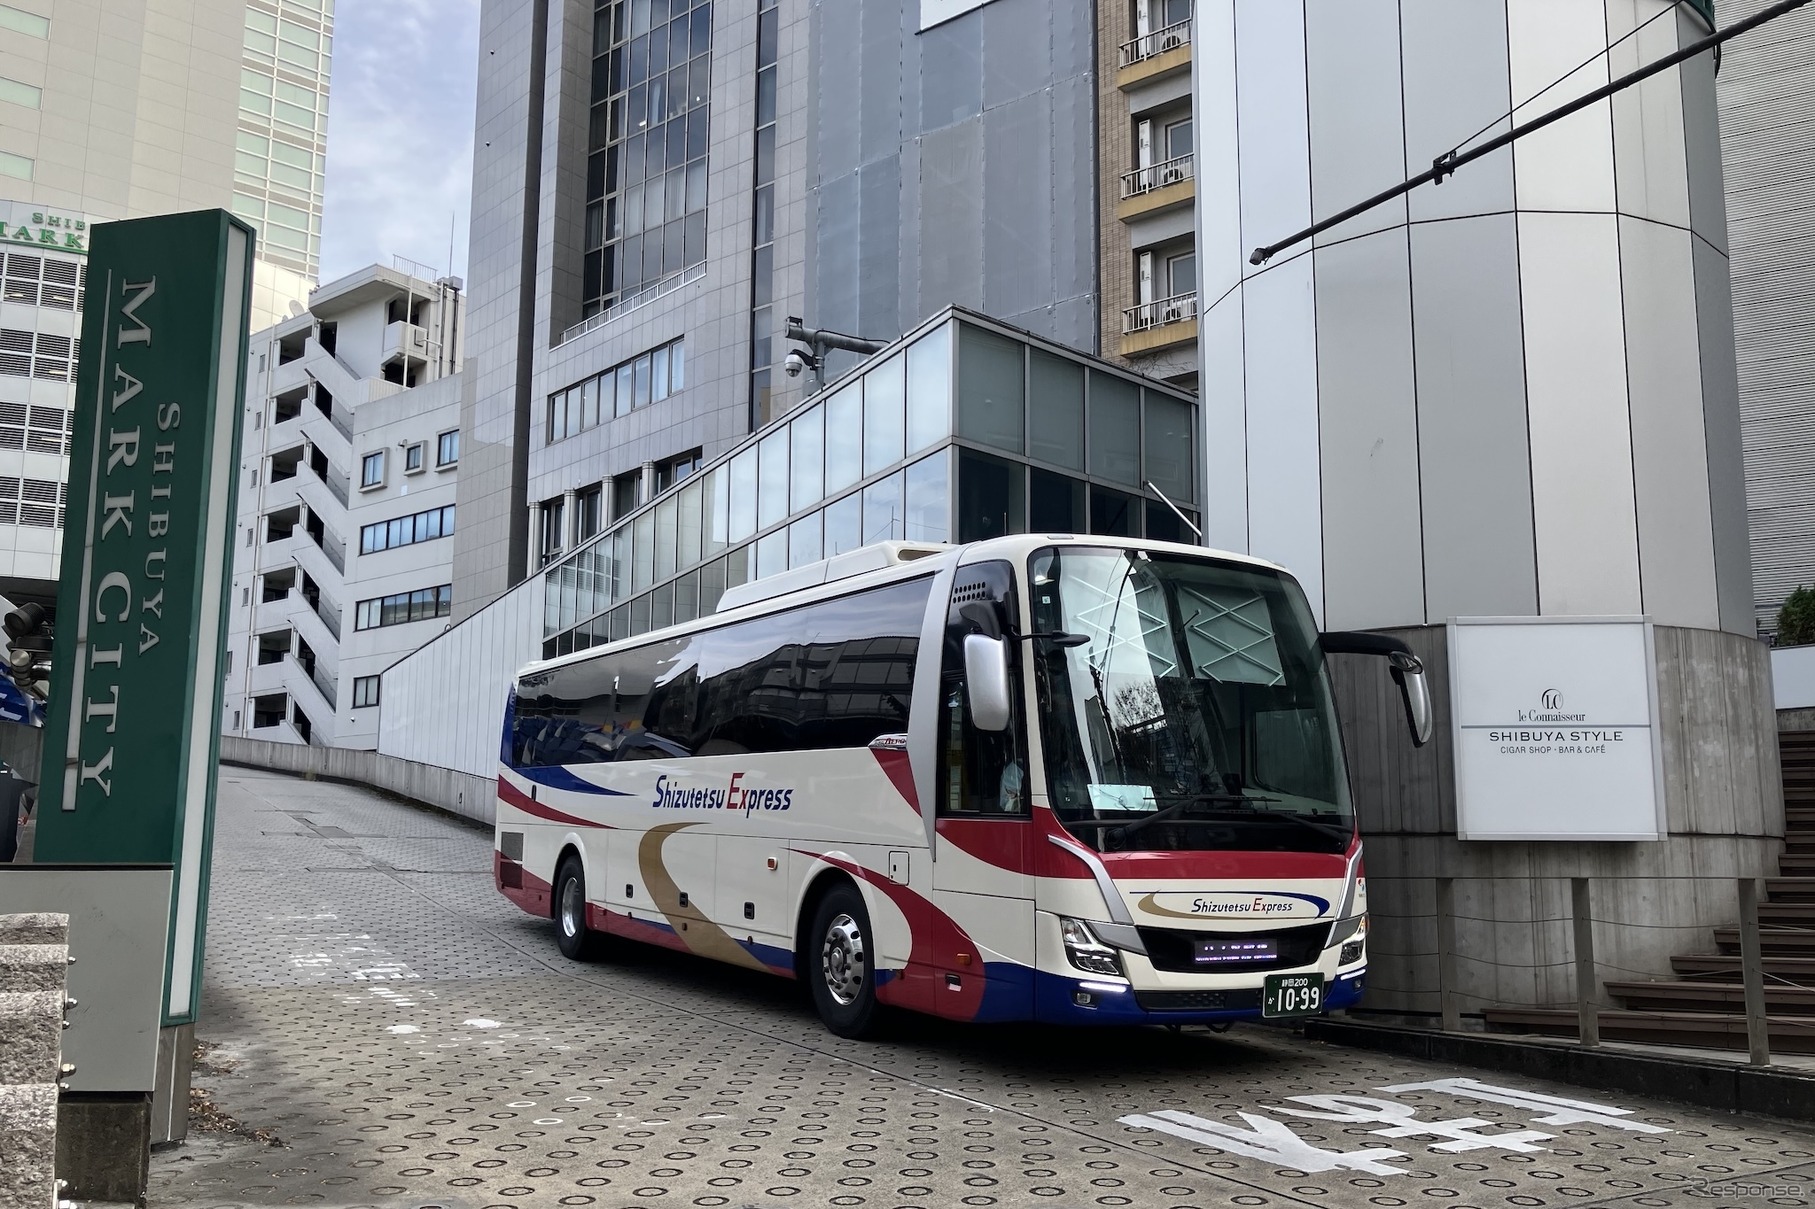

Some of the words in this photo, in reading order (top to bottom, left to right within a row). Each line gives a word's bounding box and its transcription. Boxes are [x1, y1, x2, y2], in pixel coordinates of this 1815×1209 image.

[32, 212, 86, 231] SHIB
[101, 275, 156, 541] MARK
[139, 403, 181, 656] SHIBUYA
[81, 571, 132, 797] CITY
[1518, 709, 1527, 721] le
[1528, 709, 1586, 721] Connaisseur
[1489, 732, 1565, 741] SHIBUYA
[1570, 731, 1623, 741] STYLE
[1584, 744, 1606, 753] CAFÉ
[652, 775, 725, 809] Shizutetsu
[726, 772, 794, 818] Express
[1191, 898, 1251, 912] Shizutetsu
[1252, 898, 1293, 914] Express
[1278, 987, 1320, 1012] 10-99
